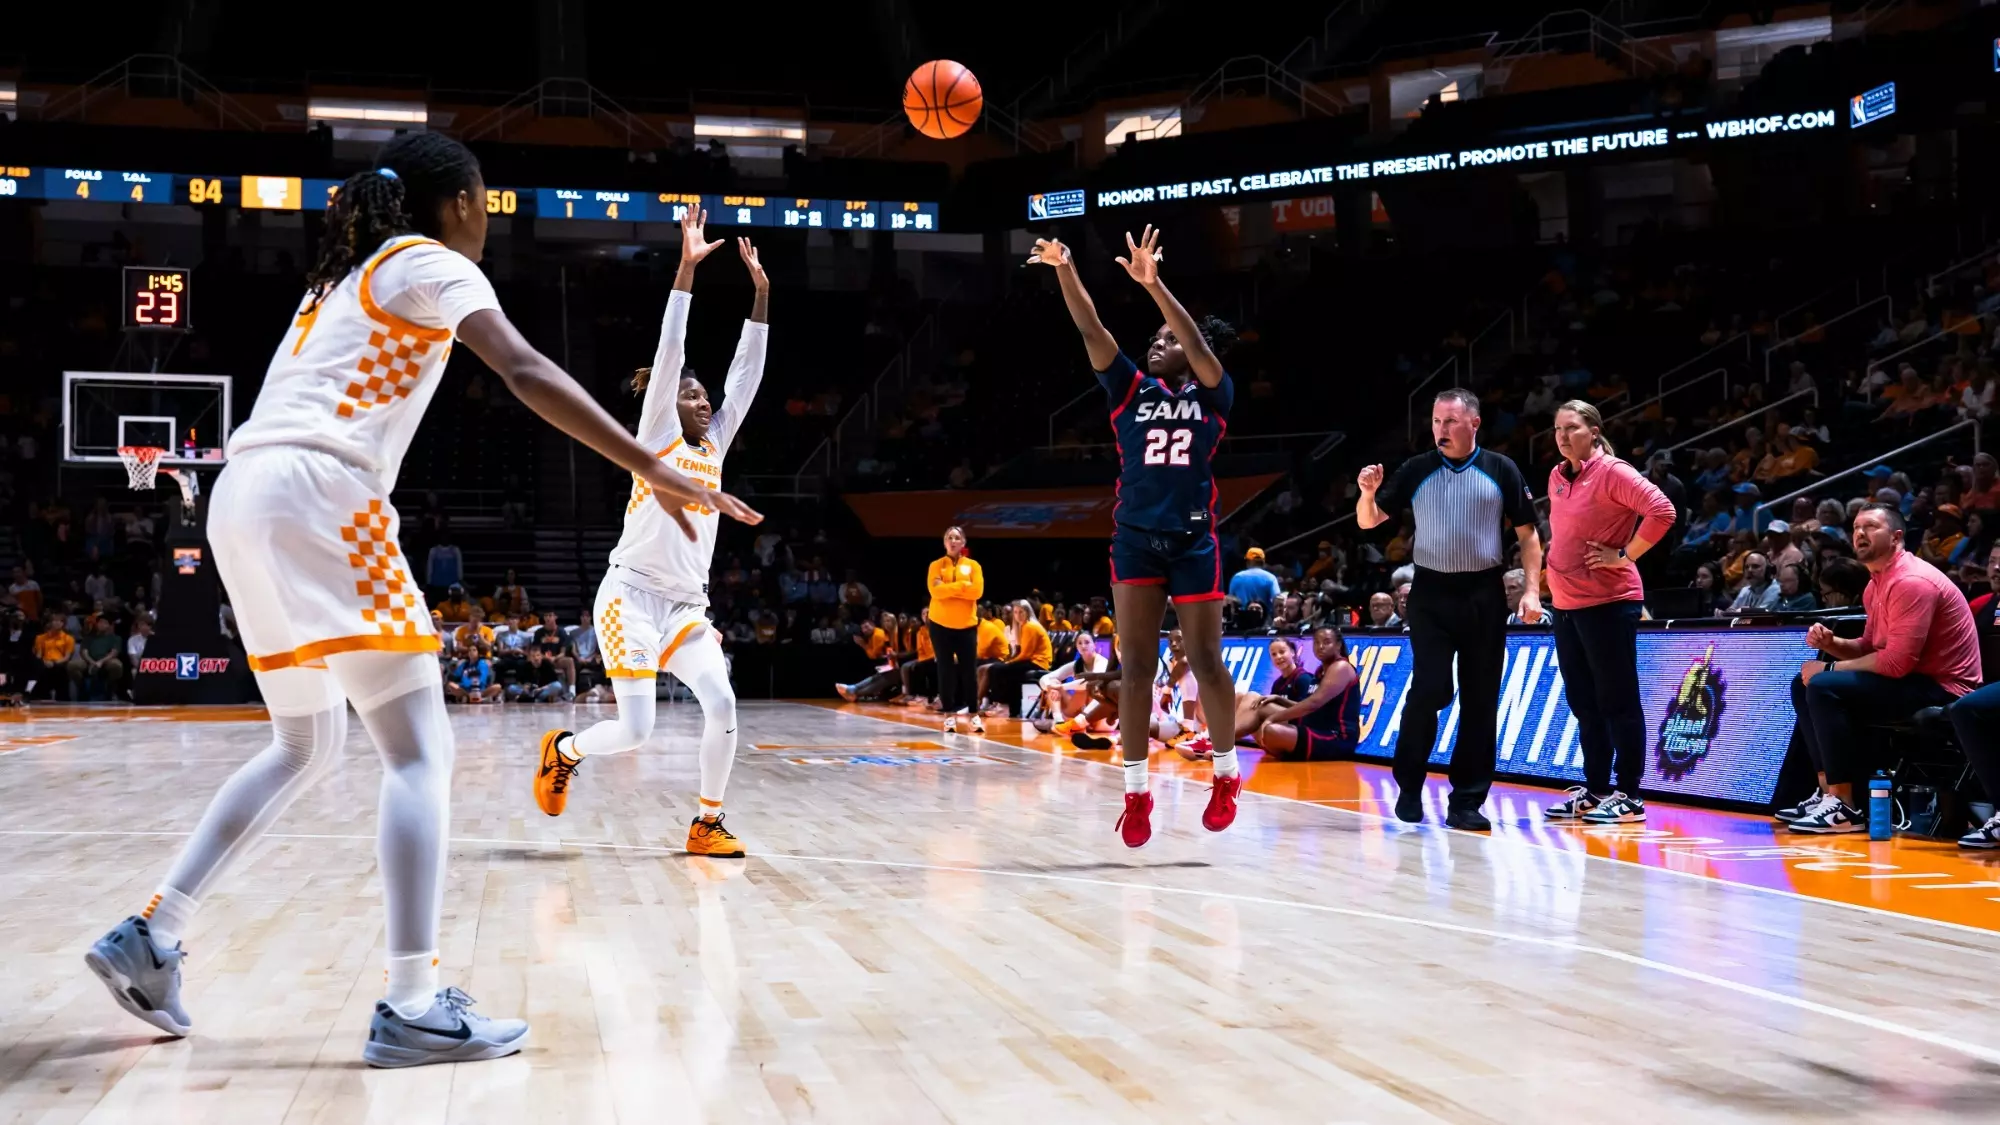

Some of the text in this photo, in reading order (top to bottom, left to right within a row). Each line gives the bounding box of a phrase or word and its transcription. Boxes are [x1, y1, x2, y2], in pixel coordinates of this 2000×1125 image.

[1098, 187, 1155, 207] HONOR
[1157, 183, 1189, 200] THE
[1191, 178, 1238, 197] PAST,
[1240, 166, 1333, 191] CELEBRATE
[1336, 162, 1370, 181] THE
[1373, 153, 1456, 177] PRESENT,
[1459, 142, 1548, 167] PROMOTE
[1551, 137, 1588, 156] THE
[1592, 128, 1668, 152] FUTURE
[1706, 110, 1835, 139] WBHOF.COM
[65, 169, 102, 181] FOULS
[76, 181, 89, 199] 4
[131, 184, 144, 202] 4
[189, 178, 223, 204] 94
[595, 191, 629, 203] FOULS
[486, 189, 517, 214] 50
[566, 201, 573, 218] 1
[606, 202, 619, 220] 4
[149, 274, 183, 292] 1:45
[136, 292, 177, 323] 23
[1144, 428, 1193, 465] 22
[676, 457, 720, 478] TENNES
[140, 658, 177, 673] FOOD
[199, 658, 230, 673] CITY
